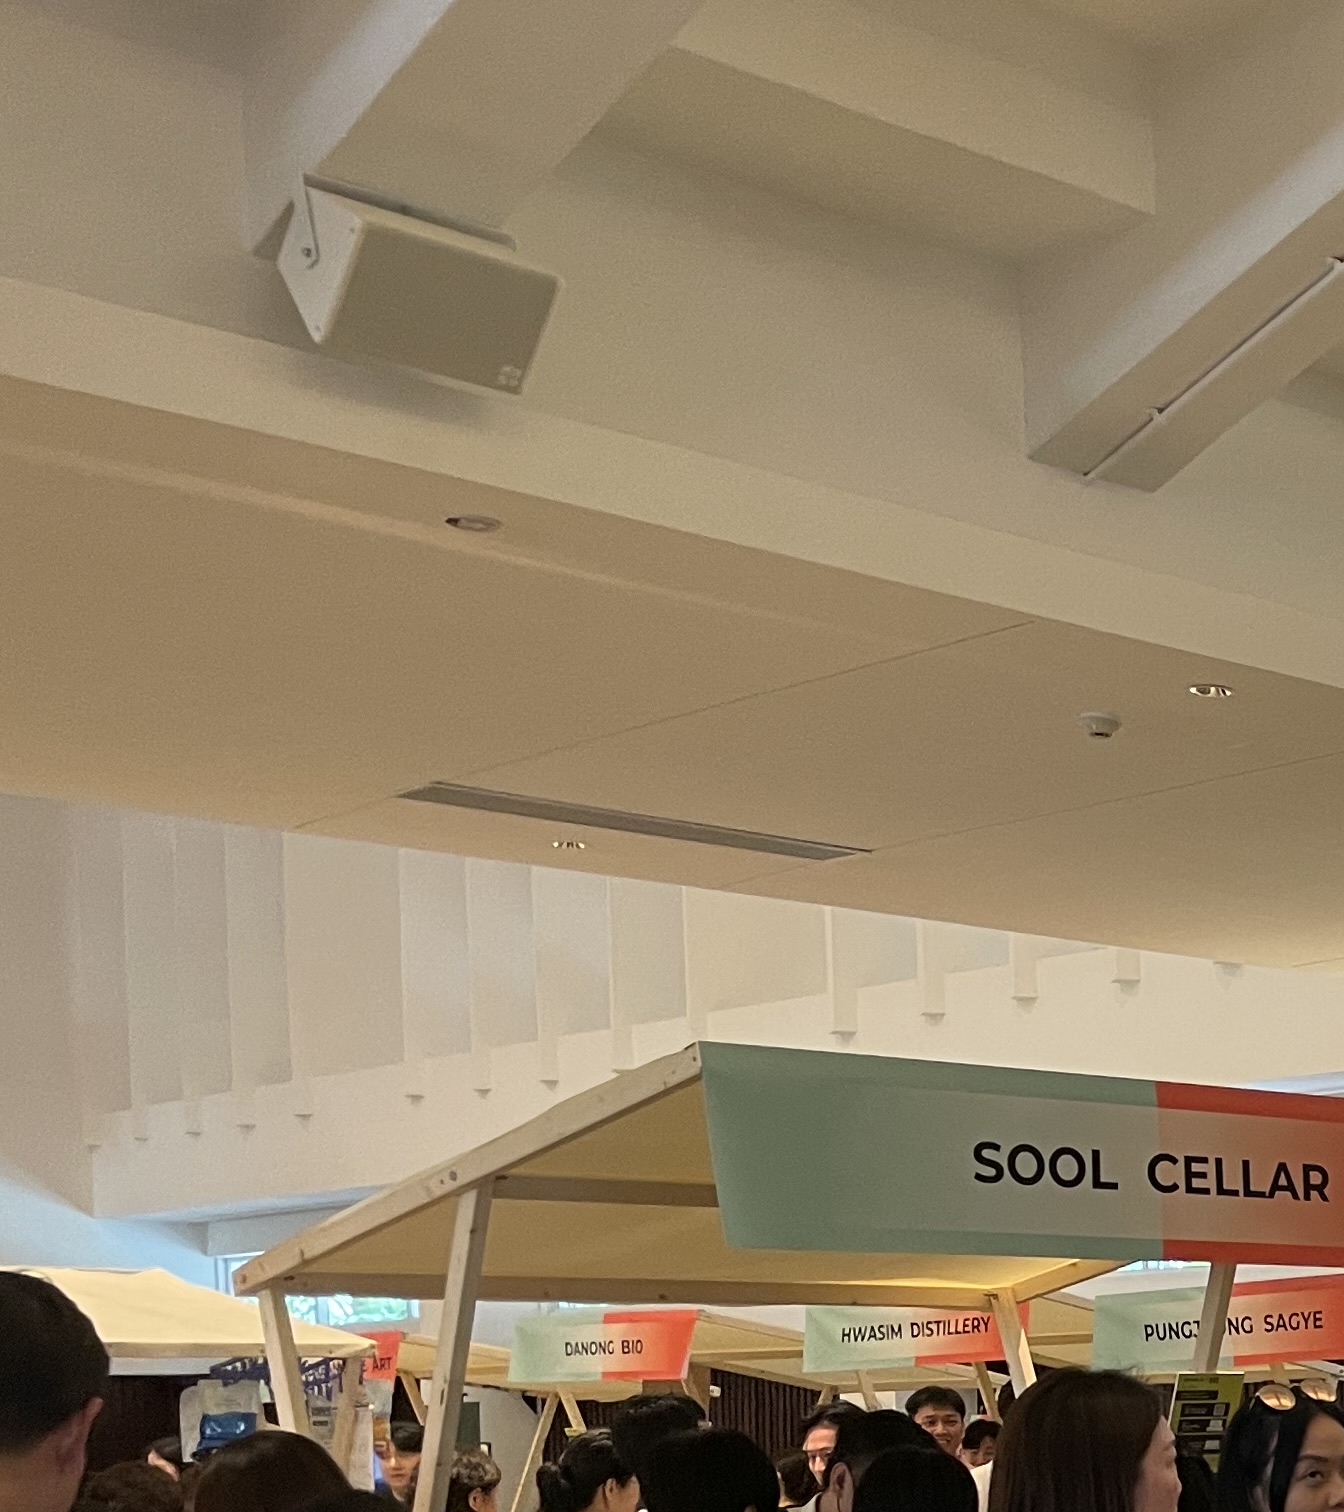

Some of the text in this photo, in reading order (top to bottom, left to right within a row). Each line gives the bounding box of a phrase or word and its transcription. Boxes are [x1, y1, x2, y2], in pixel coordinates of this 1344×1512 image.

[972, 1141, 1330, 1203] SOOL CELLAR
[841, 1315, 991, 1344] HWASIM DISTILLERY
[1263, 1311, 1324, 1333] SAGYE
[564, 1339, 644, 1357] DANONG BIO
